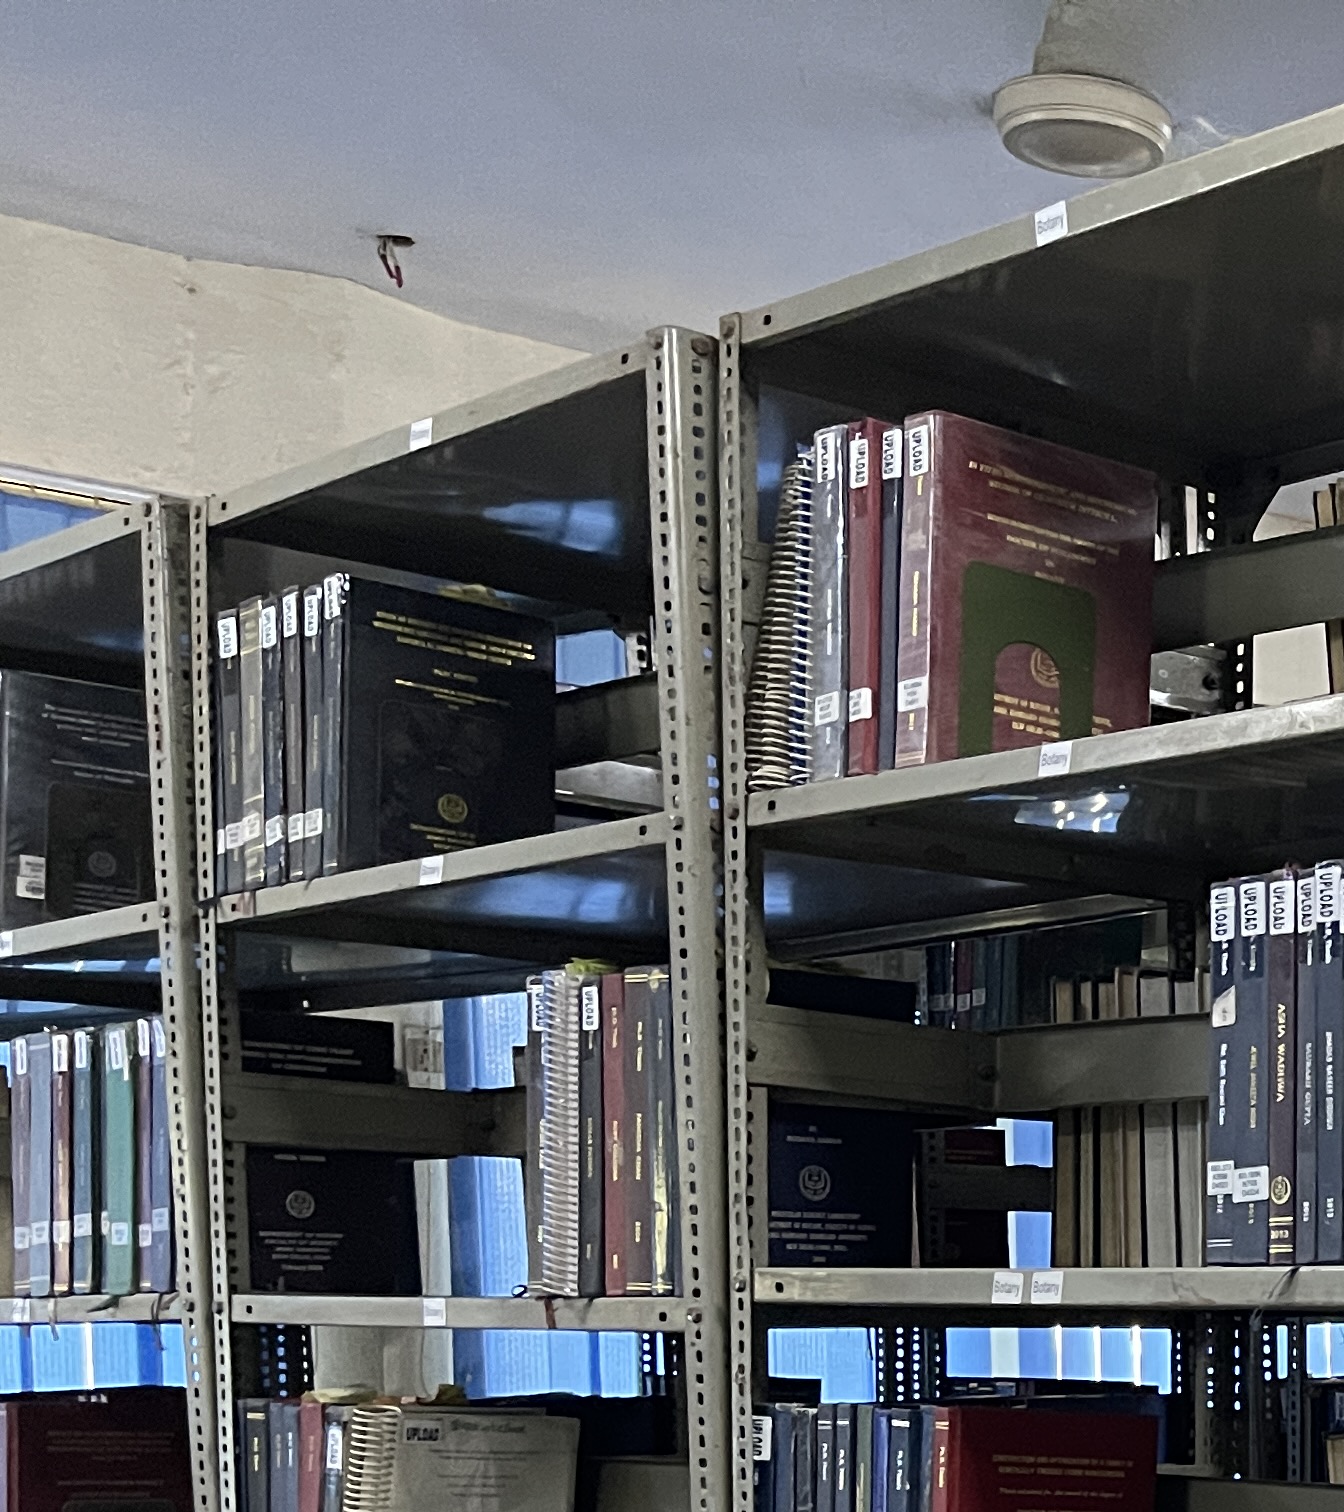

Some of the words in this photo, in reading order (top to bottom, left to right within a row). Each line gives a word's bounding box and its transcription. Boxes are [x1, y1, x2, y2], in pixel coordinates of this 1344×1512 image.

[821, 437, 829, 482] UPLOAD
[855, 444, 867, 484] UPLOAD
[883, 434, 894, 475] UPLOAD
[911, 430, 922, 472] UPLOAD
[1244, 887, 1257, 931] UPLOAD
[1273, 886, 1285, 930] UPLOAD
[1301, 883, 1312, 927] UPLOAD
[1319, 872, 1333, 918] UPLOAD
